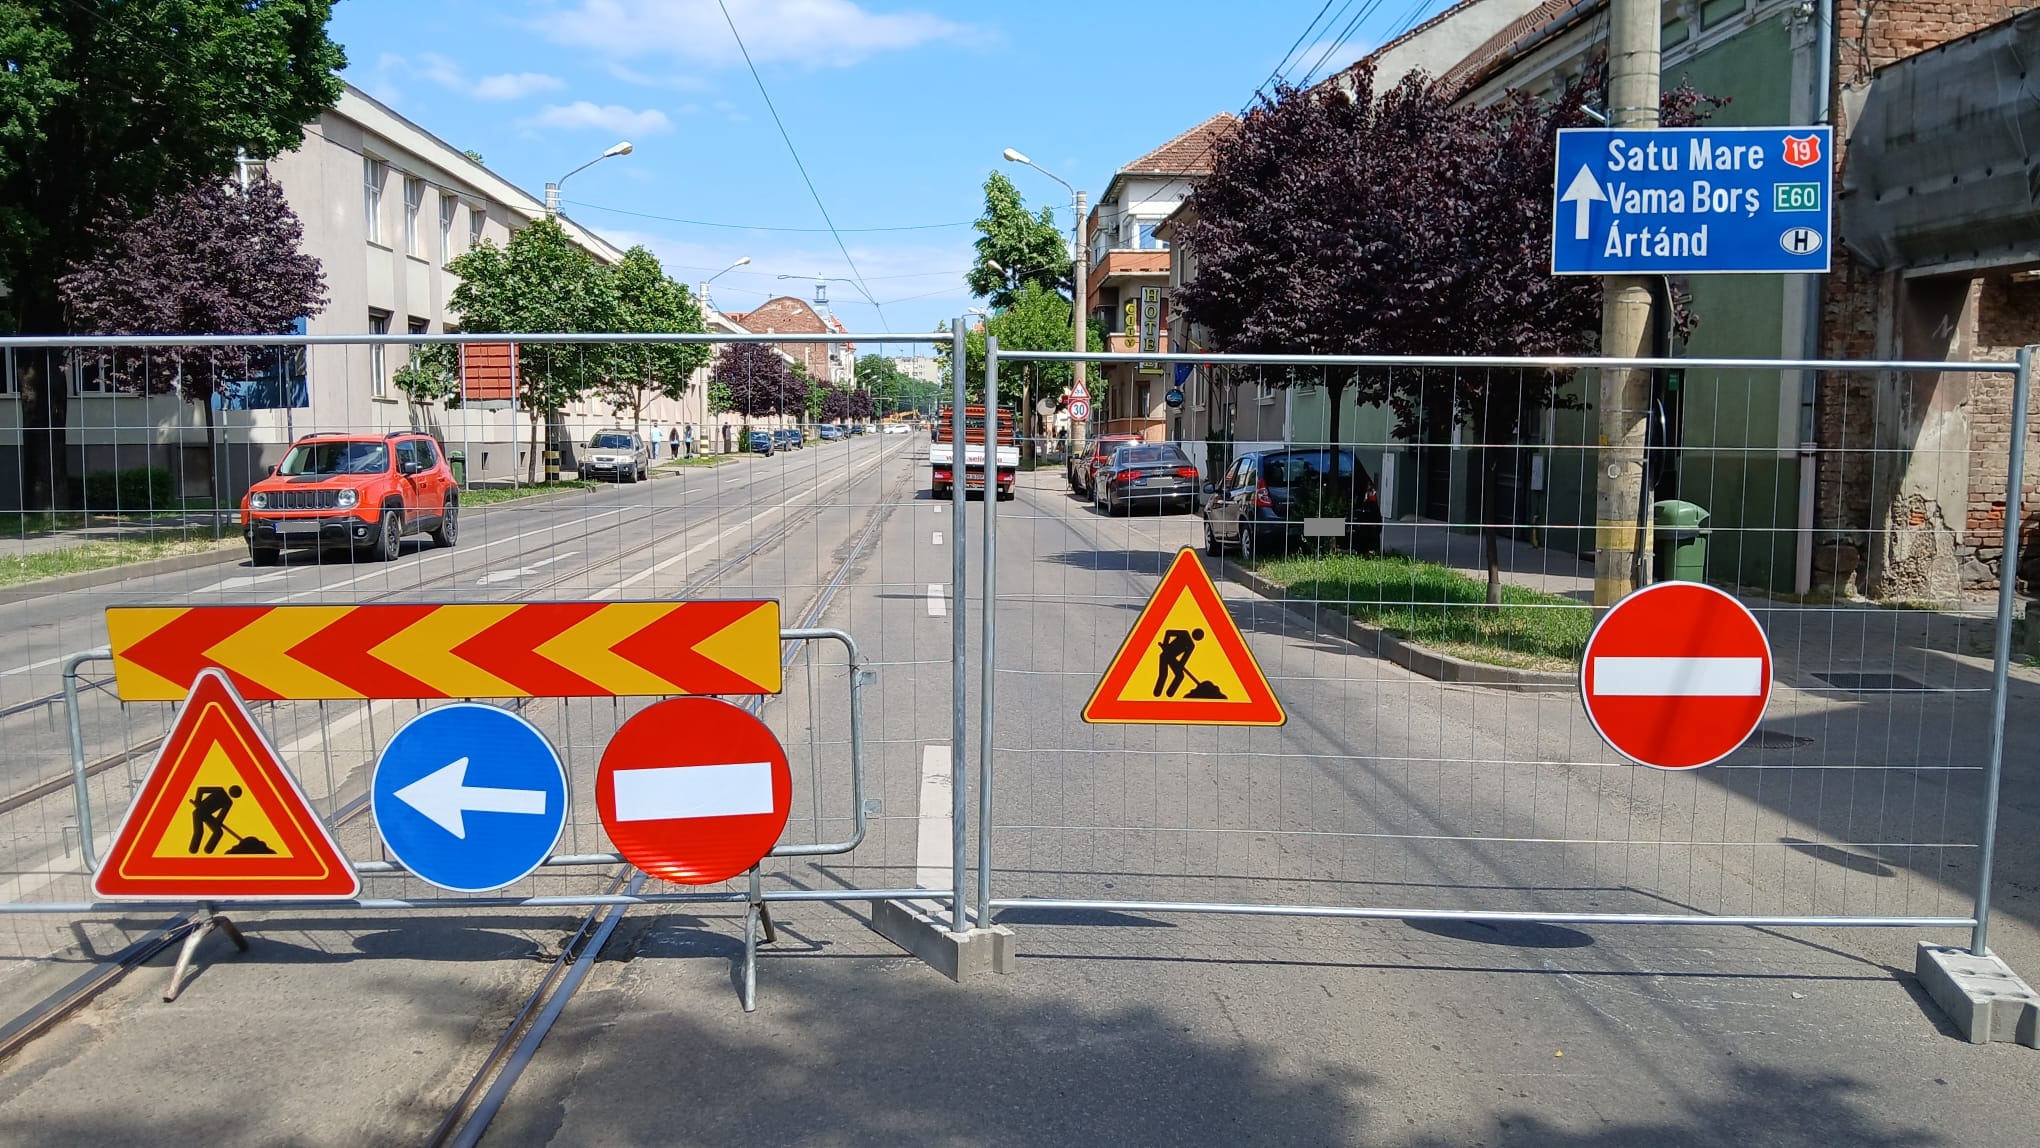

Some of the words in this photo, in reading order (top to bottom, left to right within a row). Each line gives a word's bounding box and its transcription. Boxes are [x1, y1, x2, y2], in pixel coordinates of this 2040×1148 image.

[1608, 138, 1678, 172] Satu
[1689, 138, 1764, 170] Mare
[1792, 141, 1811, 161] 19
[1606, 182, 1685, 214] Vama
[1692, 180, 1760, 218] Borș
[1778, 186, 1815, 207] E60
[1603, 219, 1708, 257] Ártánd
[1794, 230, 1808, 251] H
[1125, 304, 1135, 347] CITY
[1074, 404, 1085, 415] 30
